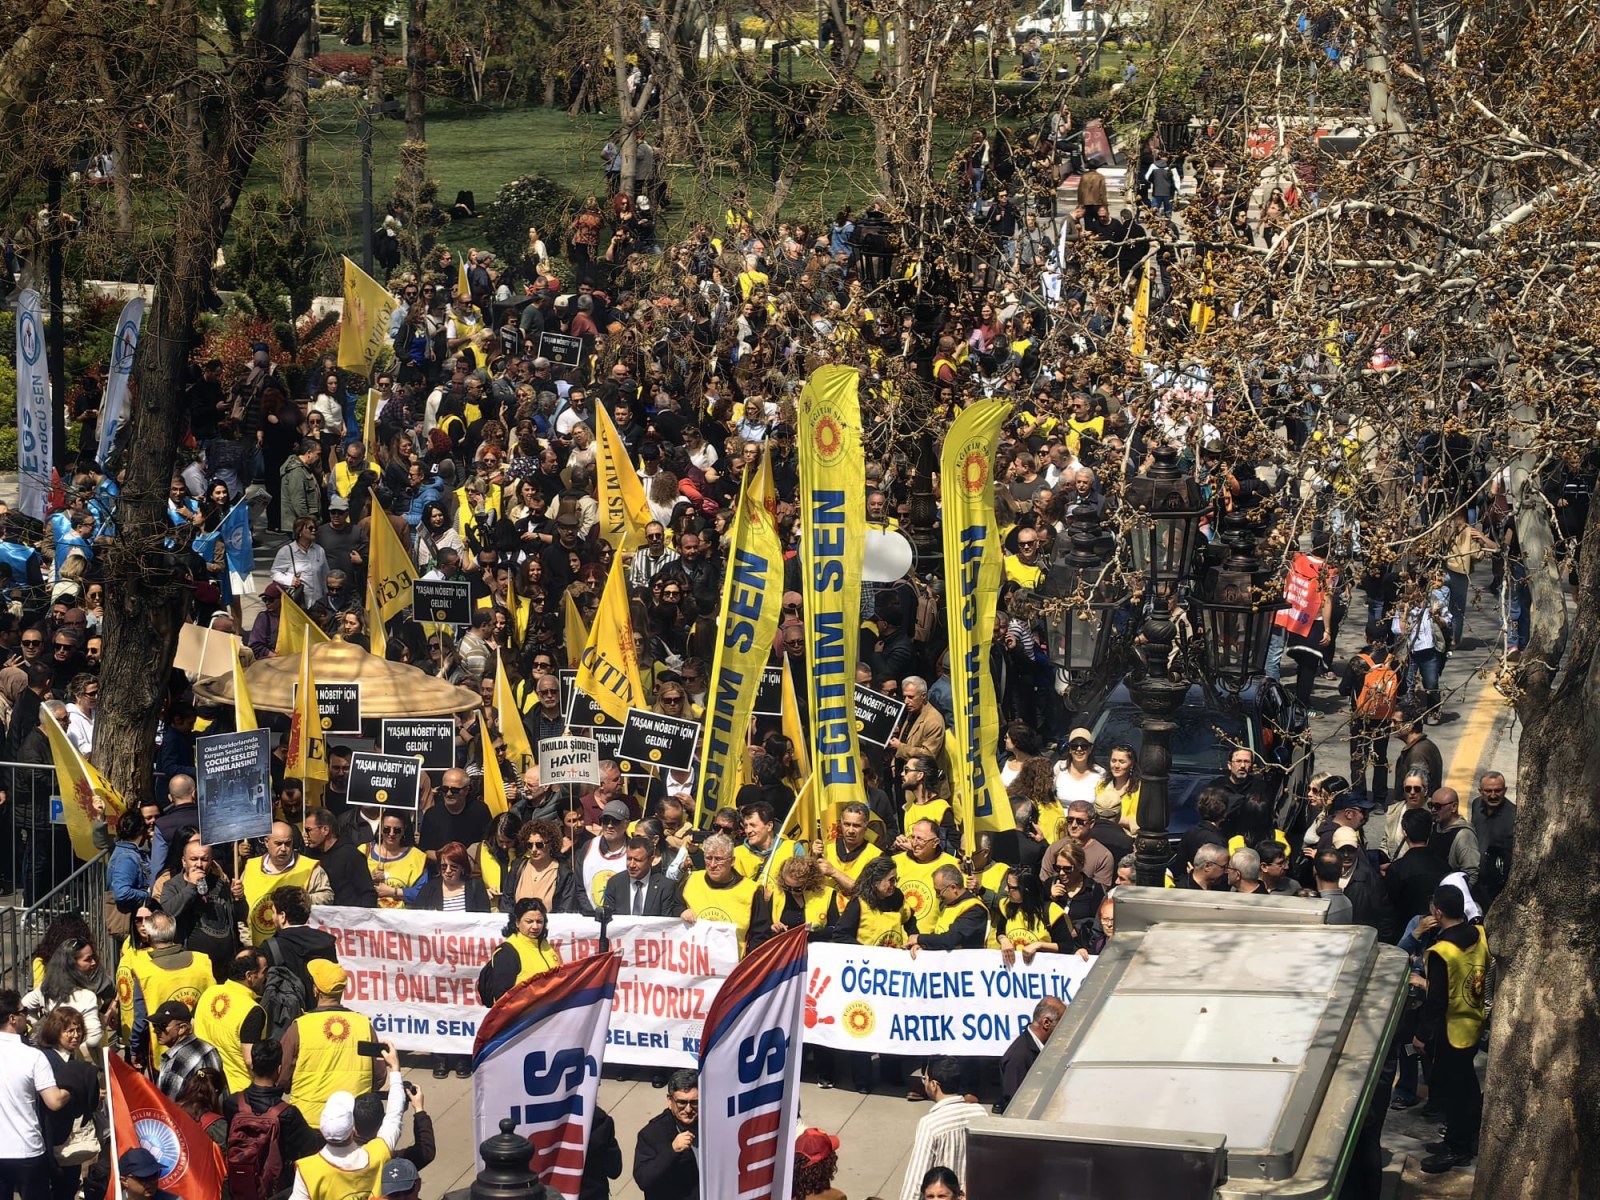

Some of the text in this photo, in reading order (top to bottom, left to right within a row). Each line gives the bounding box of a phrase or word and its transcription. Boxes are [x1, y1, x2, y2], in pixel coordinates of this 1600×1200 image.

[32, 375, 45, 406] SEN
[22, 408, 39, 474] EGS
[35, 410, 48, 456] GÜCÜ
[607, 496, 625, 534] SEN
[813, 489, 845, 594] SEN
[416, 585, 434, 597] "YAŞAM
[455, 586, 467, 599] İÇİN
[730, 548, 769, 654] SEN
[430, 597, 449, 608] GELDİK
[768, 673, 781, 687] İÇİN
[319, 687, 356, 702] NÖBETİ" İÇİN
[319, 703, 335, 715] ELDİK
[884, 701, 899, 717] İÇİN
[387, 724, 451, 740] "YAŞAM NÖBETİ" İÇİN
[630, 716, 695, 740] "YAŞAM NÖBETİ" İÇİN
[204, 736, 258, 753] Okul Koridorlarında
[405, 740, 429, 751] GELDİK
[541, 738, 596, 753] OKULDA ŞİDDETE
[595, 733, 616, 746] "YAŞAM
[645, 734, 668, 748] GELDİK
[204, 751, 224, 761] Kurşun
[225, 746, 244, 756] Sesleri
[205, 750, 258, 768] ÇOCUK SESLERİ
[550, 752, 591, 769] HAYIR!
[355, 758, 416, 775] "YAŞAM NÖBETİ" İÇİN
[370, 775, 393, 788] GELDİK
[51, 800, 63, 820] P
[314, 919, 413, 961] RETMEN
[634, 931, 716, 977] EDİLSİN.
[343, 965, 388, 1001] DETİ
[841, 959, 1072, 1002] ÖĞRETMENE YÖNELİK
[612, 974, 708, 1020] STİYORUZ.
[369, 1013, 476, 1037] ĞİTİM SEN
[889, 1013, 956, 1041] ARTIK
[962, 1014, 1011, 1041] SON
[605, 1030, 669, 1048] BELERİ
